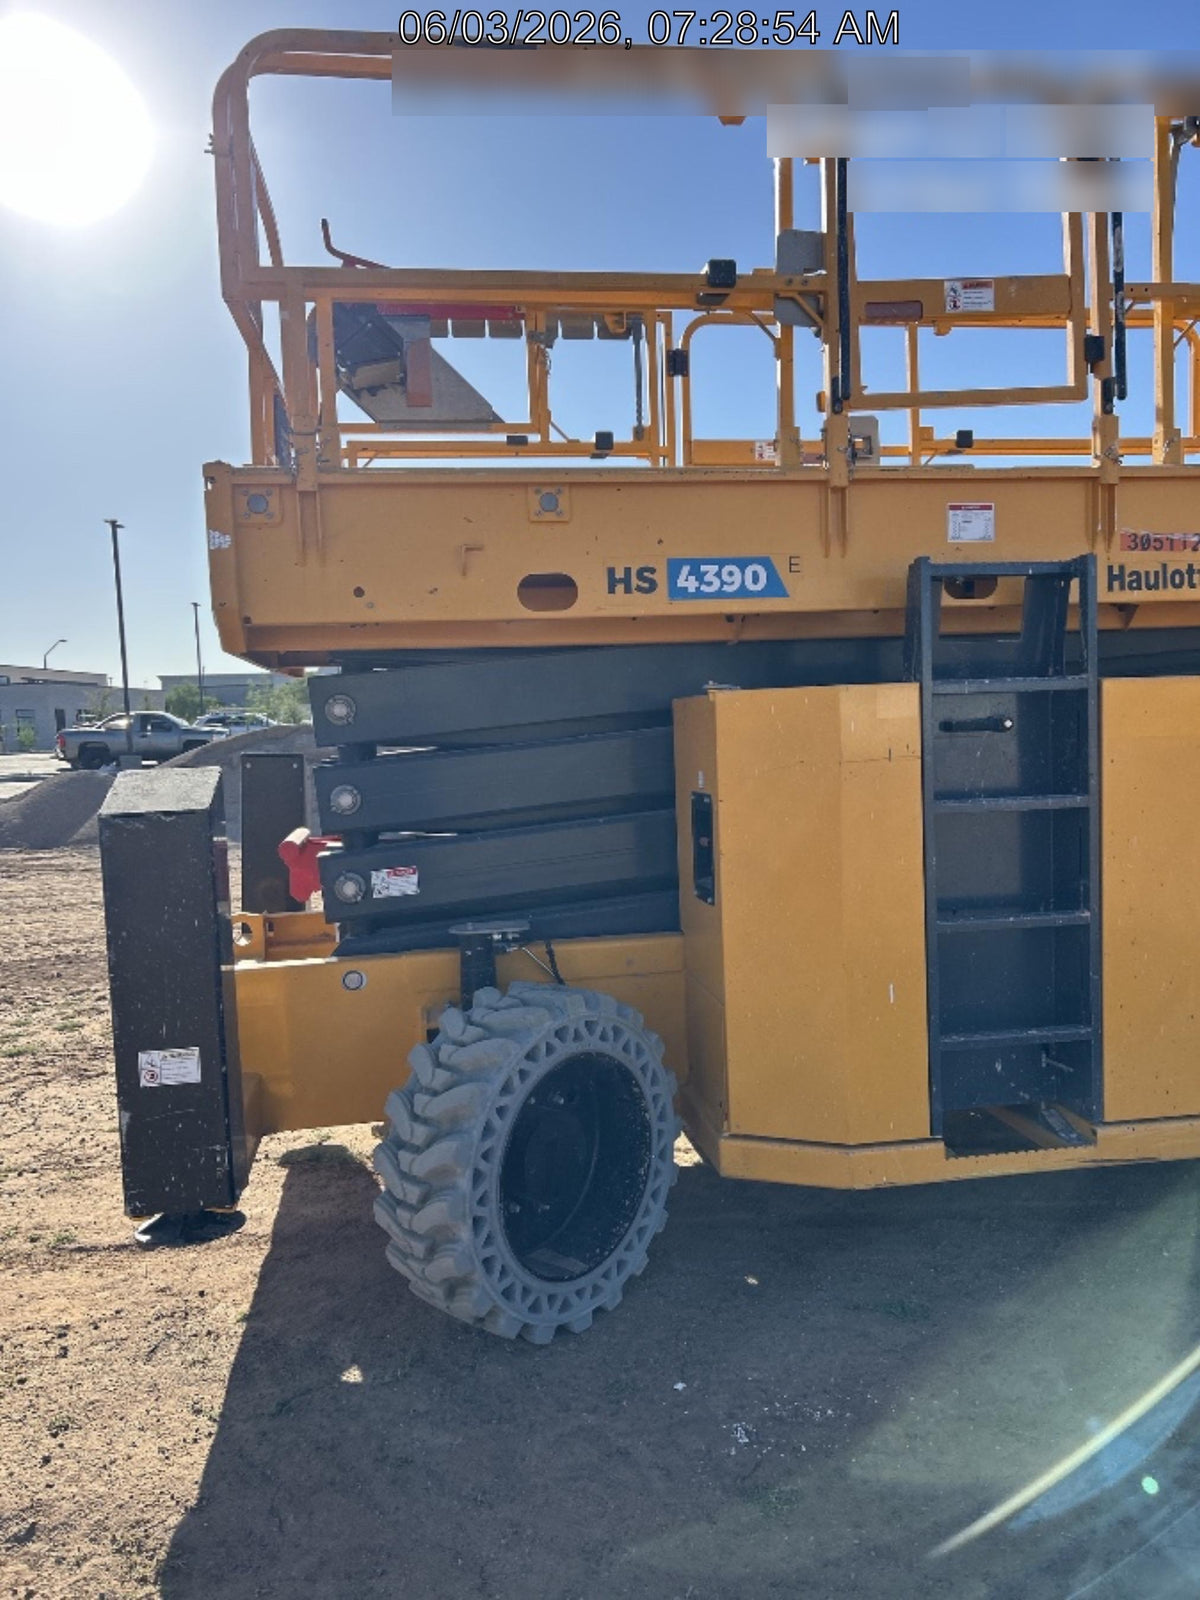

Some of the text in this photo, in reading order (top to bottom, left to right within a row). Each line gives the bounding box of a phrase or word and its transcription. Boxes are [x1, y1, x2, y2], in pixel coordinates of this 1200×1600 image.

[607, 556, 801, 594] HS 4390 E
